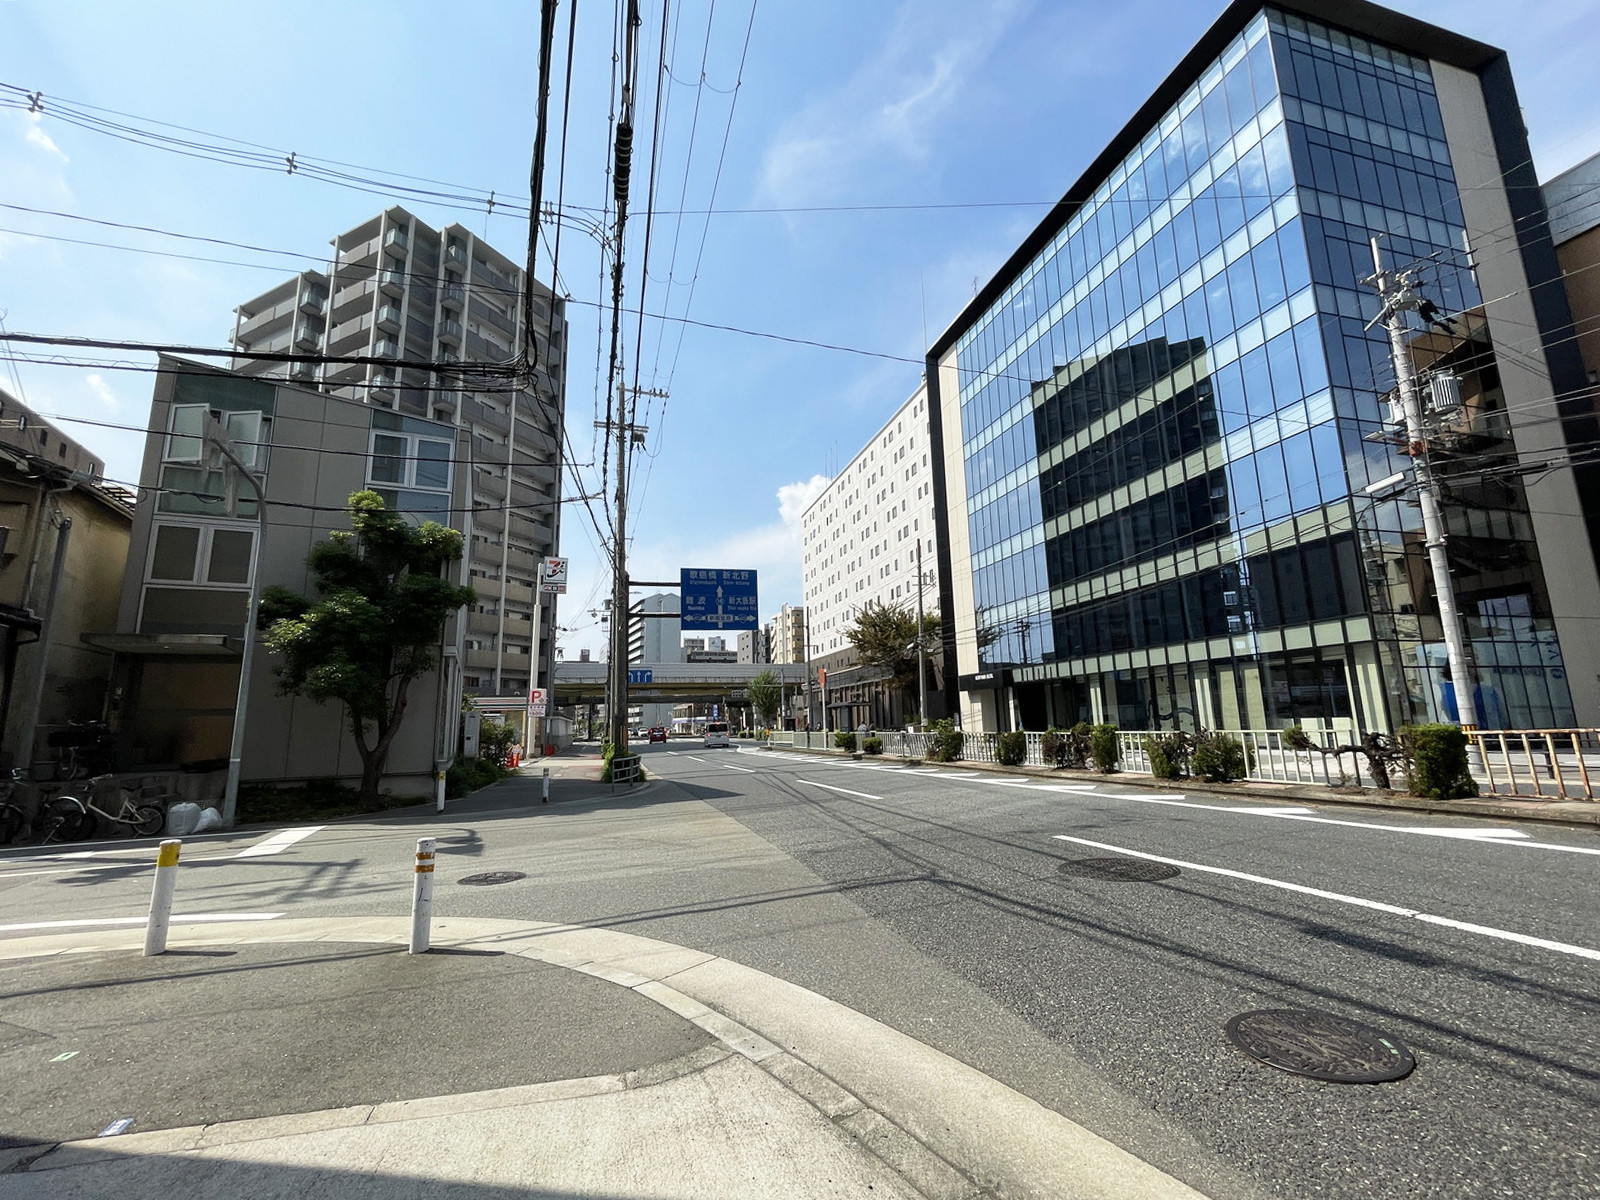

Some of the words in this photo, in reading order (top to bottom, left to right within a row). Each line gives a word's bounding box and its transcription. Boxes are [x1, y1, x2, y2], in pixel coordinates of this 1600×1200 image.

[722, 571, 749, 580] 新北野
[531, 690, 542, 703] P
